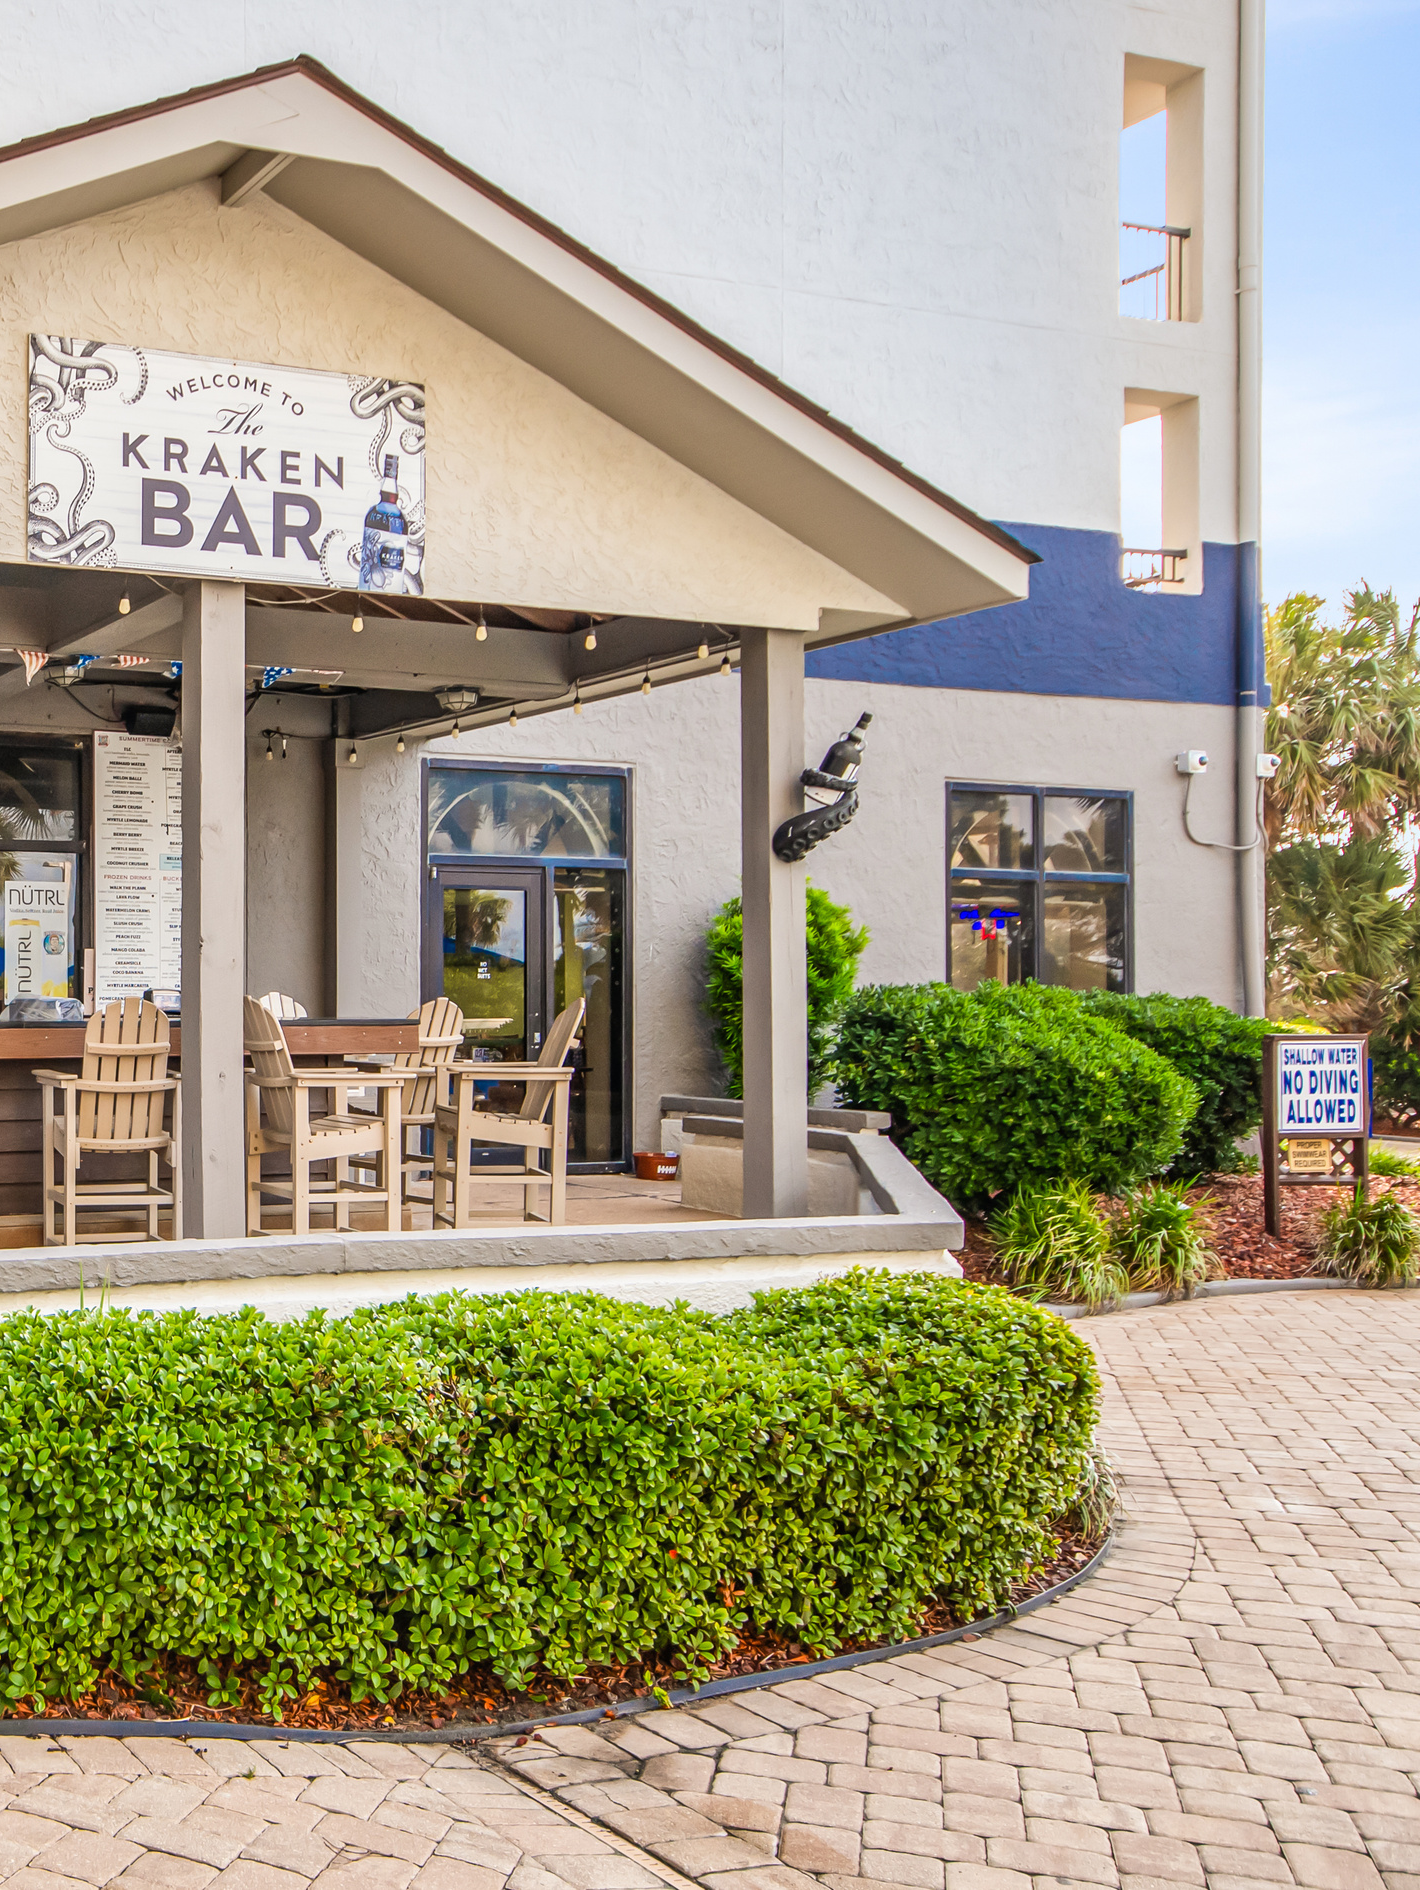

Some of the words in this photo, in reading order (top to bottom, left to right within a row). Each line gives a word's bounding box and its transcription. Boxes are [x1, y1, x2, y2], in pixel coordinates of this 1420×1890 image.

[165, 373, 272, 401] WELCOME
[282, 391, 305, 416] TO
[207, 402, 264, 436] The
[122, 432, 344, 490] KRAKEN
[141, 477, 323, 561] BAR
[1284, 1048, 1324, 1065] SHALLOW
[1328, 1048, 1357, 1065] WATER
[1283, 1070, 1303, 1095] NO
[1309, 1069, 1359, 1094] DIVING
[1287, 1099, 1356, 1124] ALLOWED
[1296, 1141, 1322, 1149] PROPER
